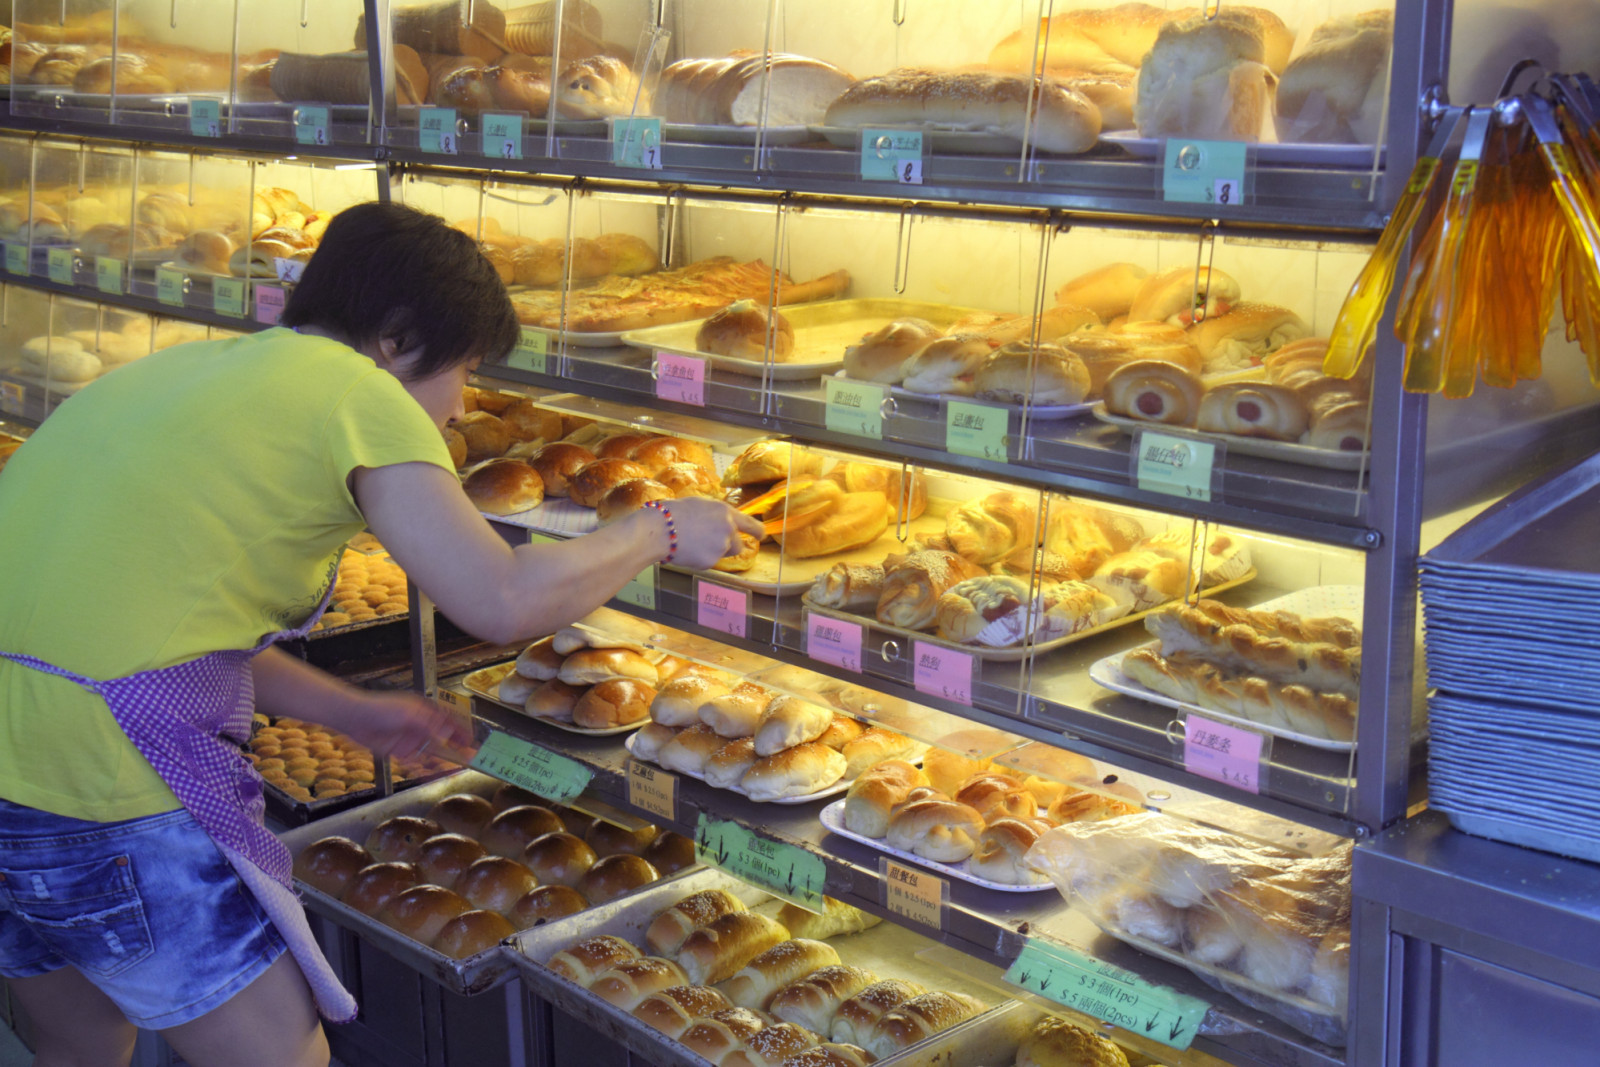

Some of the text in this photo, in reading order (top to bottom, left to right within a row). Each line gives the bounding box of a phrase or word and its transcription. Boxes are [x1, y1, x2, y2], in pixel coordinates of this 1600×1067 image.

[648, 149, 655, 169] 7
[904, 162, 913, 183] 8
[1220, 183, 1231, 205] 8
